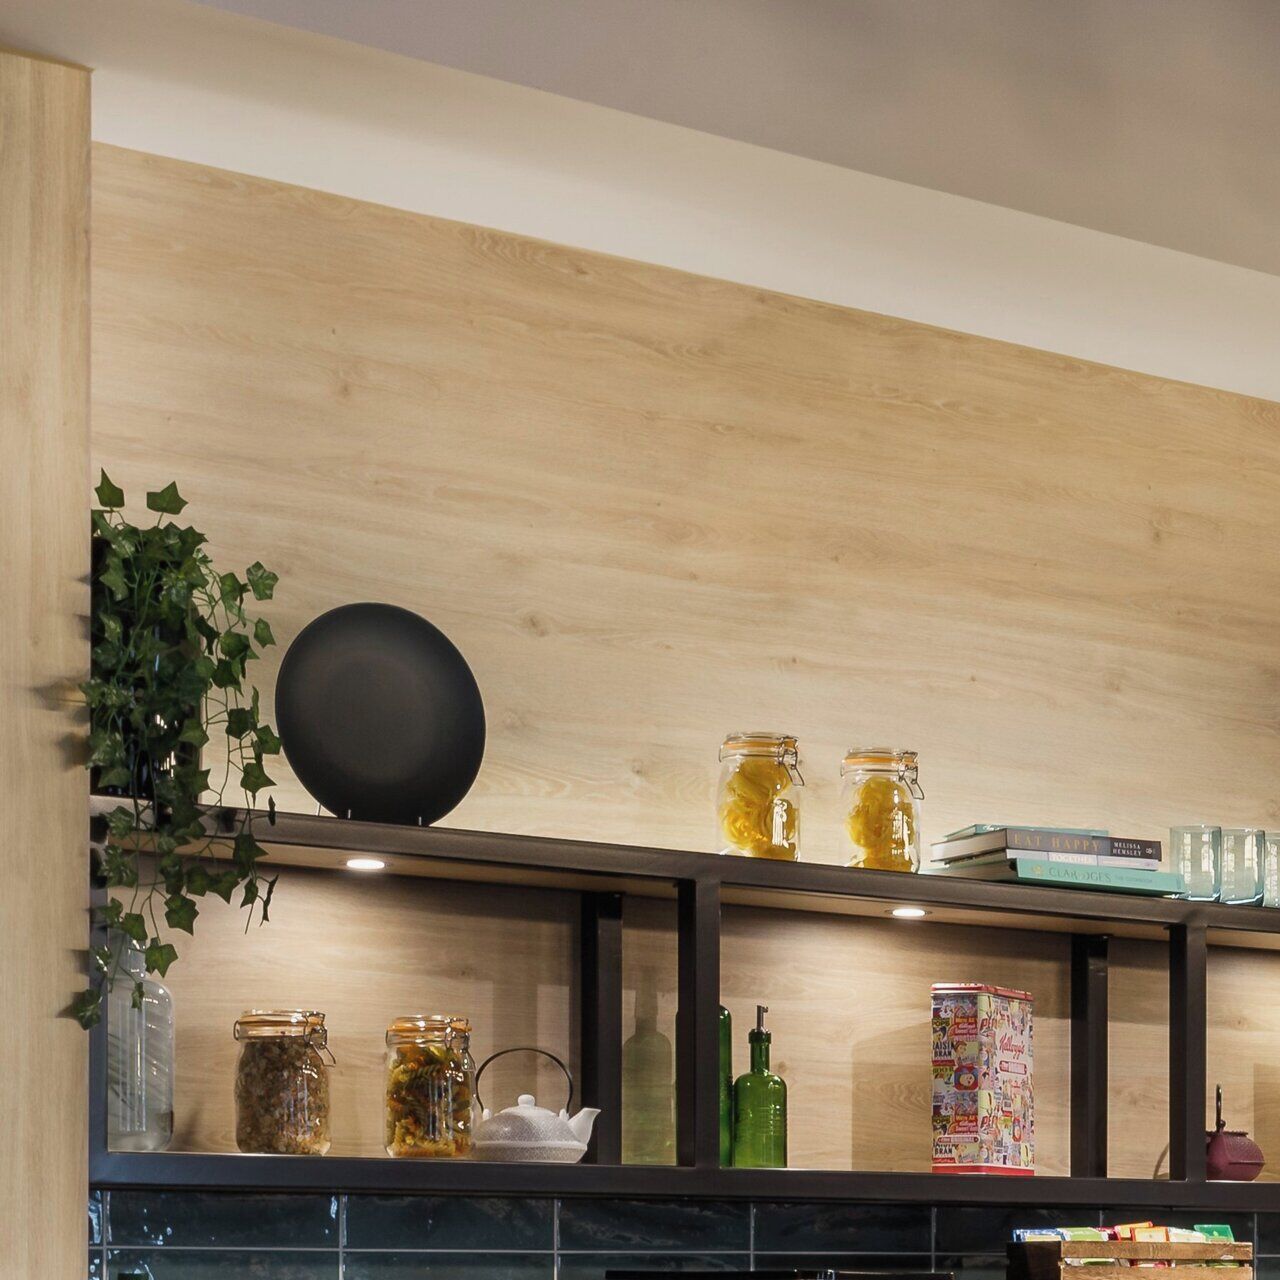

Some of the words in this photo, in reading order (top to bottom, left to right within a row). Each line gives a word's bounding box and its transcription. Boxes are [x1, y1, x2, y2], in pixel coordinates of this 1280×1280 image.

[1013, 832, 1042, 847] EAT
[1052, 836, 1100, 851] HAPPY
[1113, 841, 1141, 850] MELISSA
